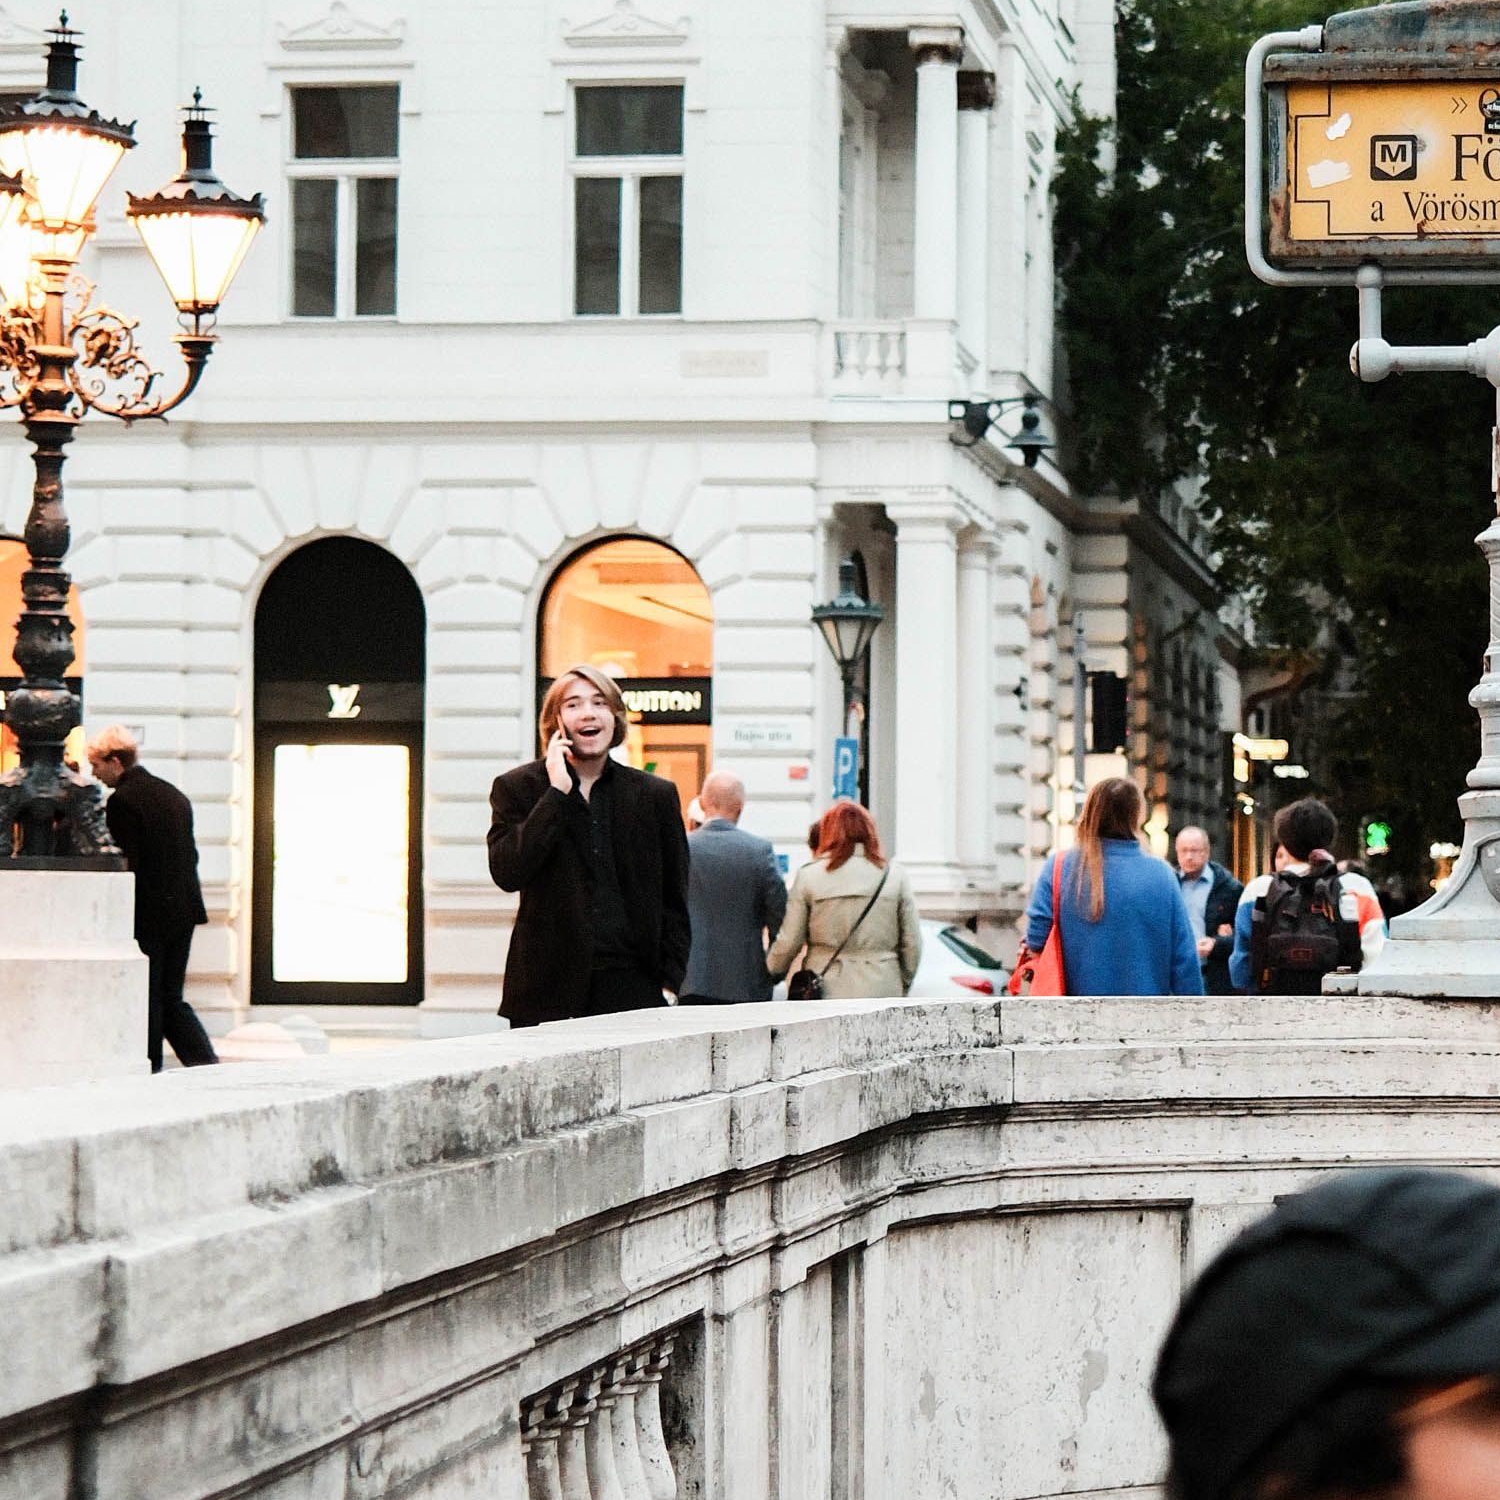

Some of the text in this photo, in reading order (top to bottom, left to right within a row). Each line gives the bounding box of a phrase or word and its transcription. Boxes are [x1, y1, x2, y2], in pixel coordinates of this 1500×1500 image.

[1380, 144, 1407, 163] M
[1370, 200, 1385, 222] a
[838, 746, 852, 790] P
